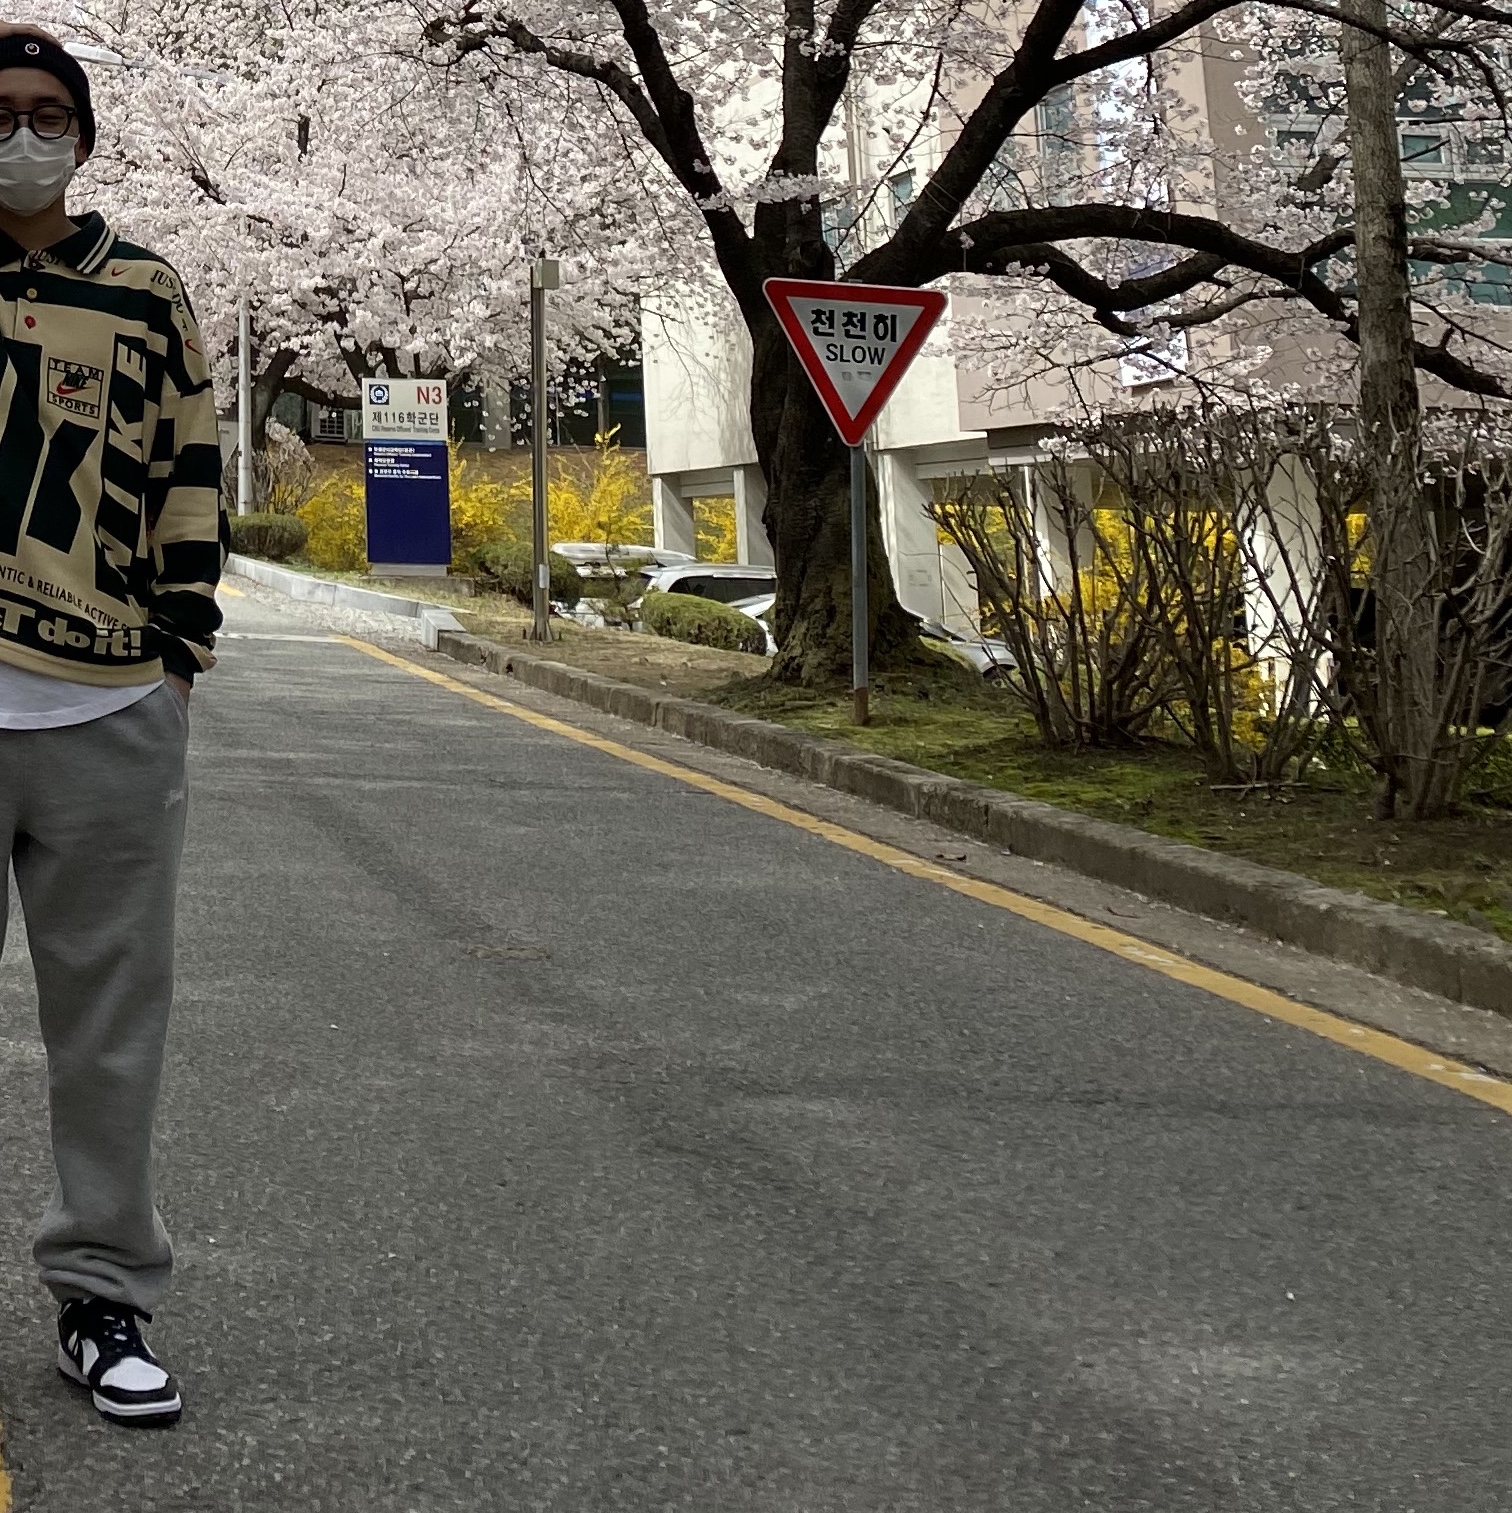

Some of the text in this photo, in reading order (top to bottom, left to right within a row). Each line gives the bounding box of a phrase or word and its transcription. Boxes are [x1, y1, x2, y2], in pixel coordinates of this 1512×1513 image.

[810, 308, 897, 343] 천천히
[825, 343, 886, 365] SLOW
[51, 358, 102, 381] TEAM
[51, 394, 96, 415] SPORTS
[416, 386, 442, 405] N3
[27, 576, 34, 588] &
[36, 580, 83, 608] RELIABLE
[84, 604, 119, 629] ACTIVE
[38, 617, 90, 648] do
